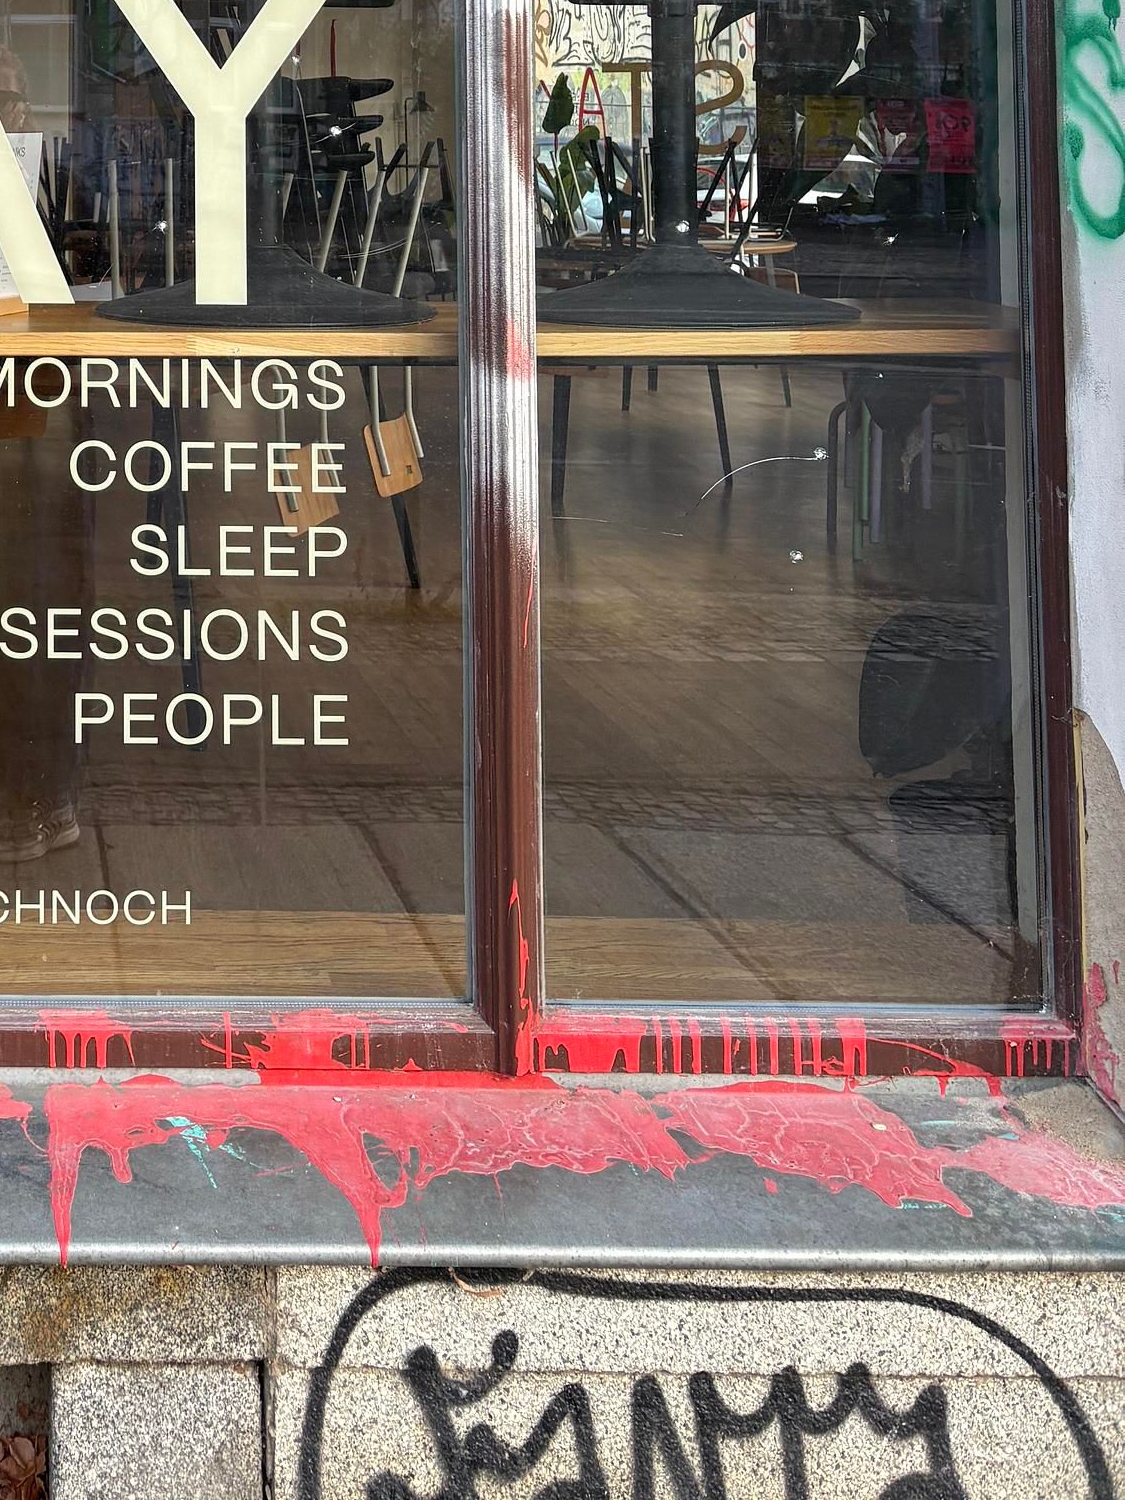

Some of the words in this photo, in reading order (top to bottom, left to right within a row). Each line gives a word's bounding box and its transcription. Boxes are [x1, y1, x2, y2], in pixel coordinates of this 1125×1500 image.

[69, 440, 347, 493] COFFEE
[130, 524, 348, 577] SLEEP
[74, 692, 349, 746] PEOPLE
